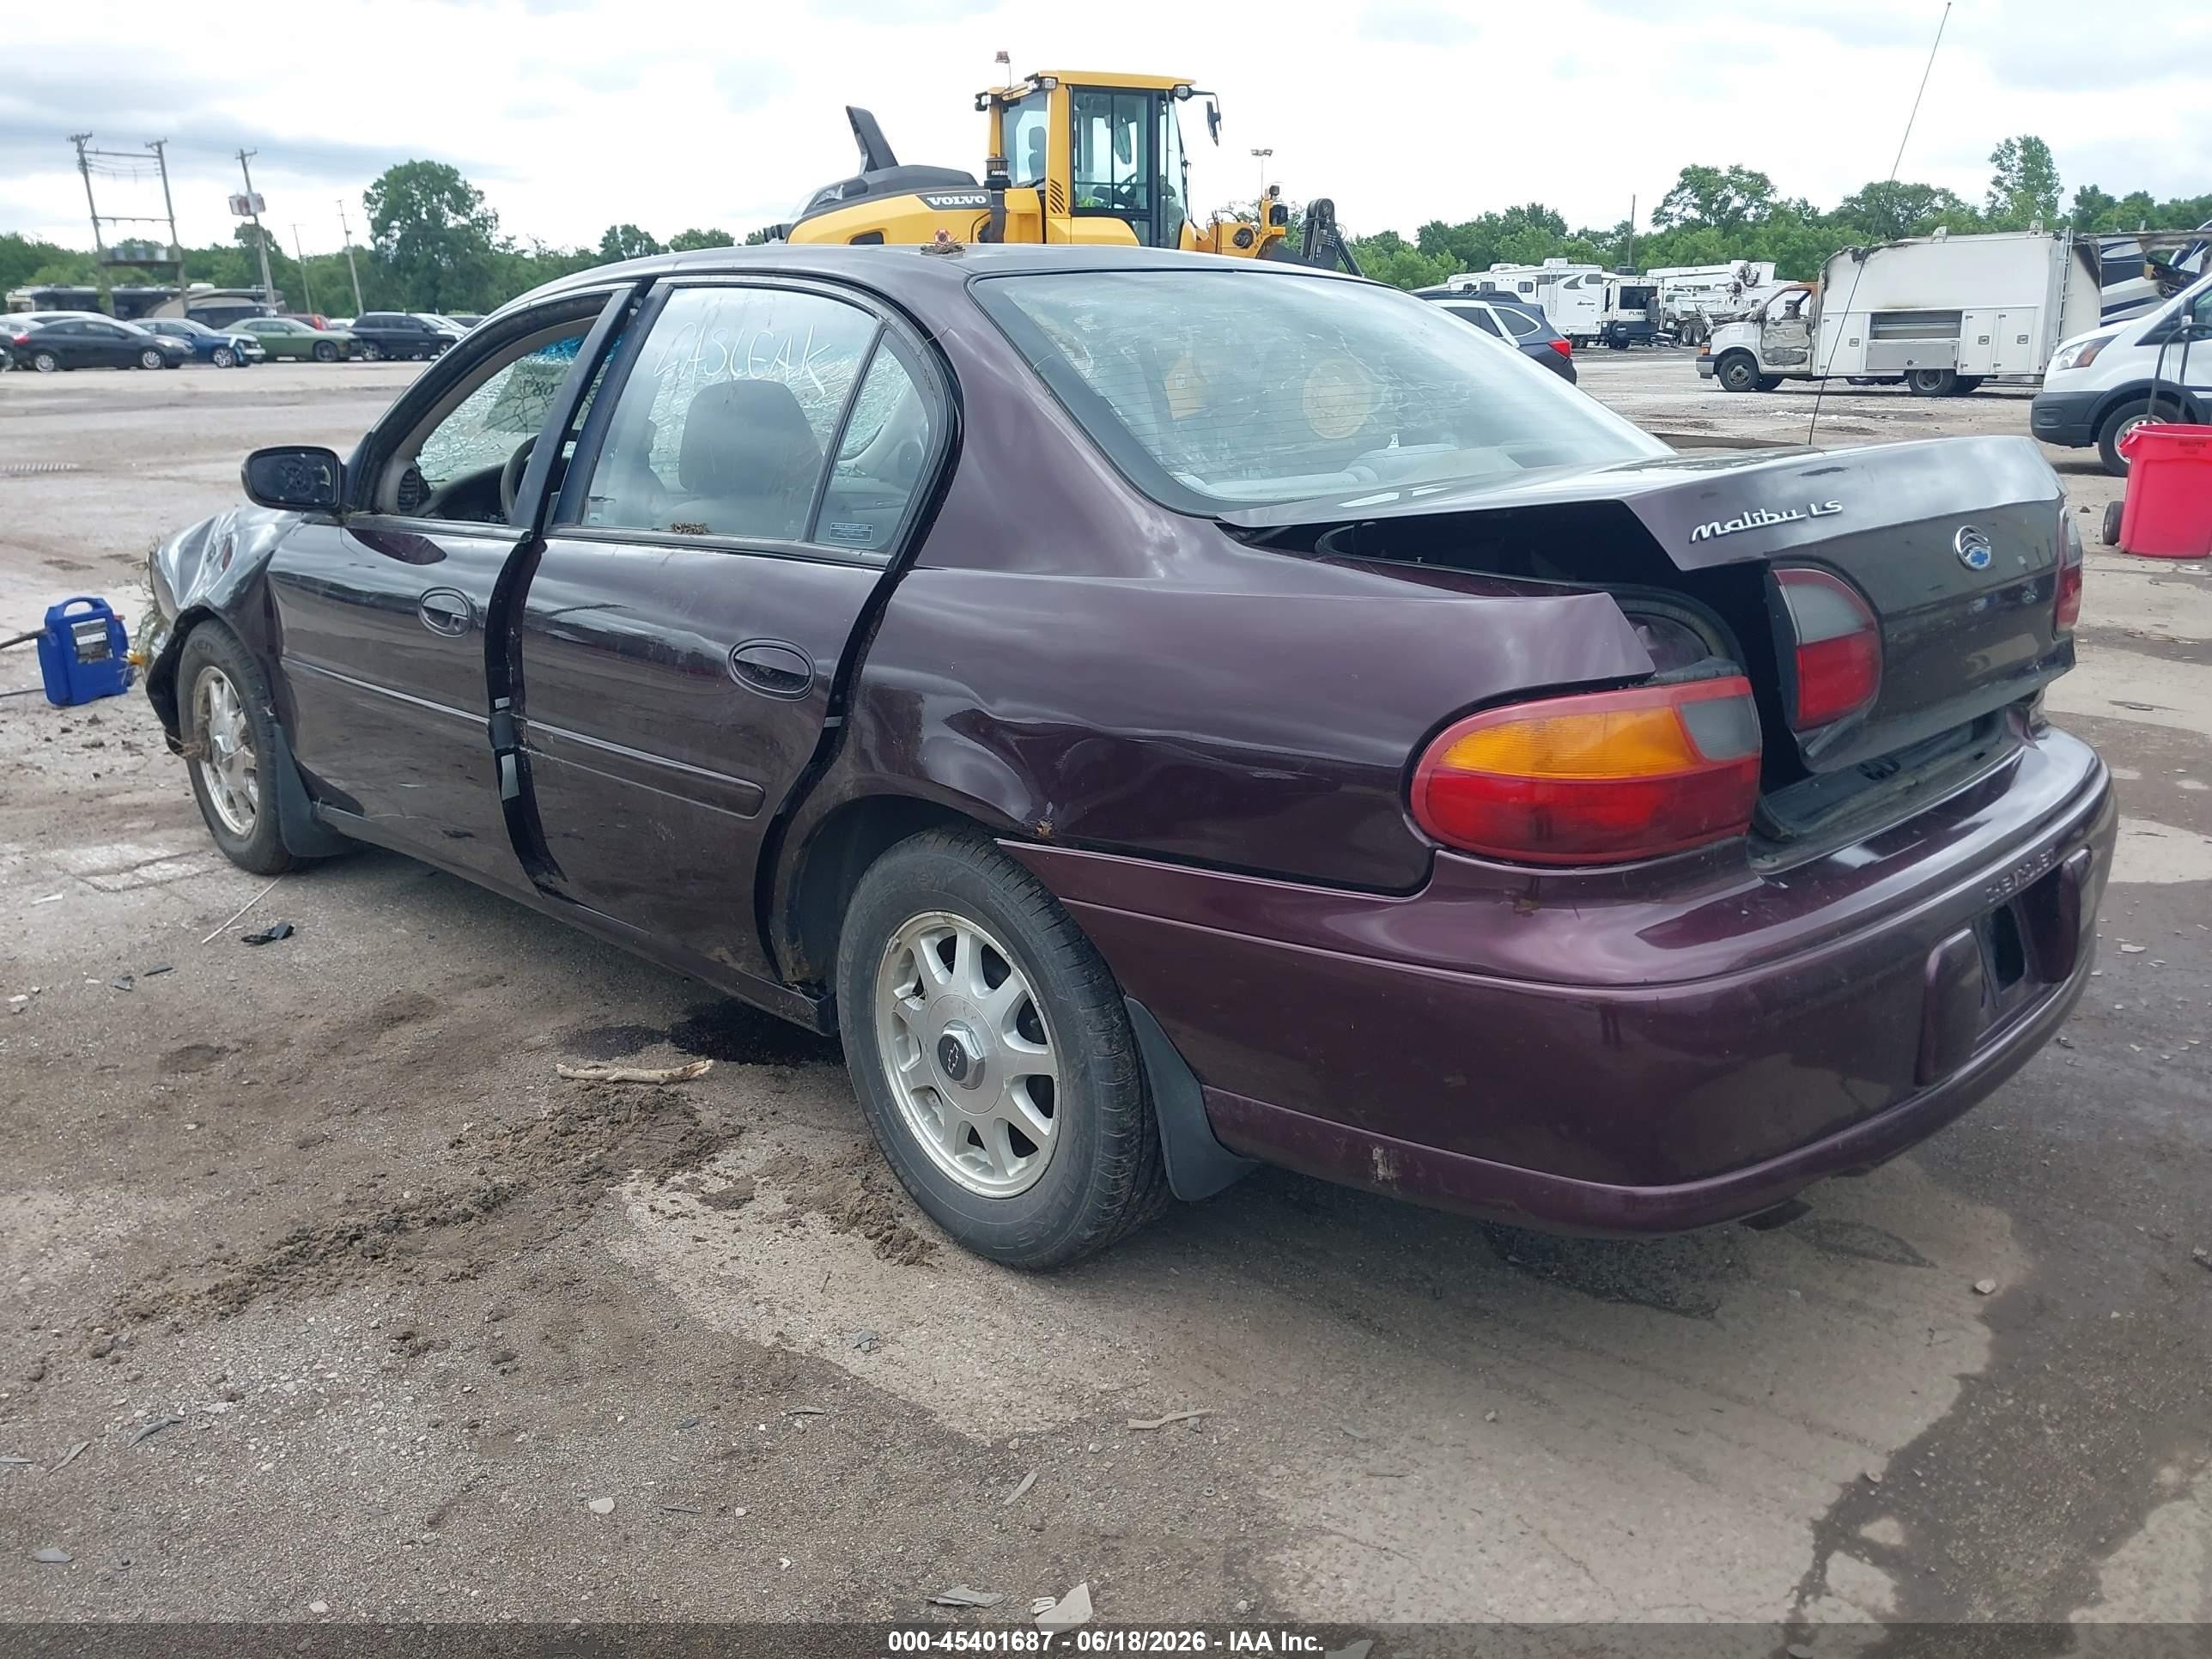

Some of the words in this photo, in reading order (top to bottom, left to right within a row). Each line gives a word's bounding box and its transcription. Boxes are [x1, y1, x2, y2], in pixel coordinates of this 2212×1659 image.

[927, 195, 987, 206] VOLVO
[1690, 508, 1807, 544] Malibu
[1808, 500, 1844, 516] LS
